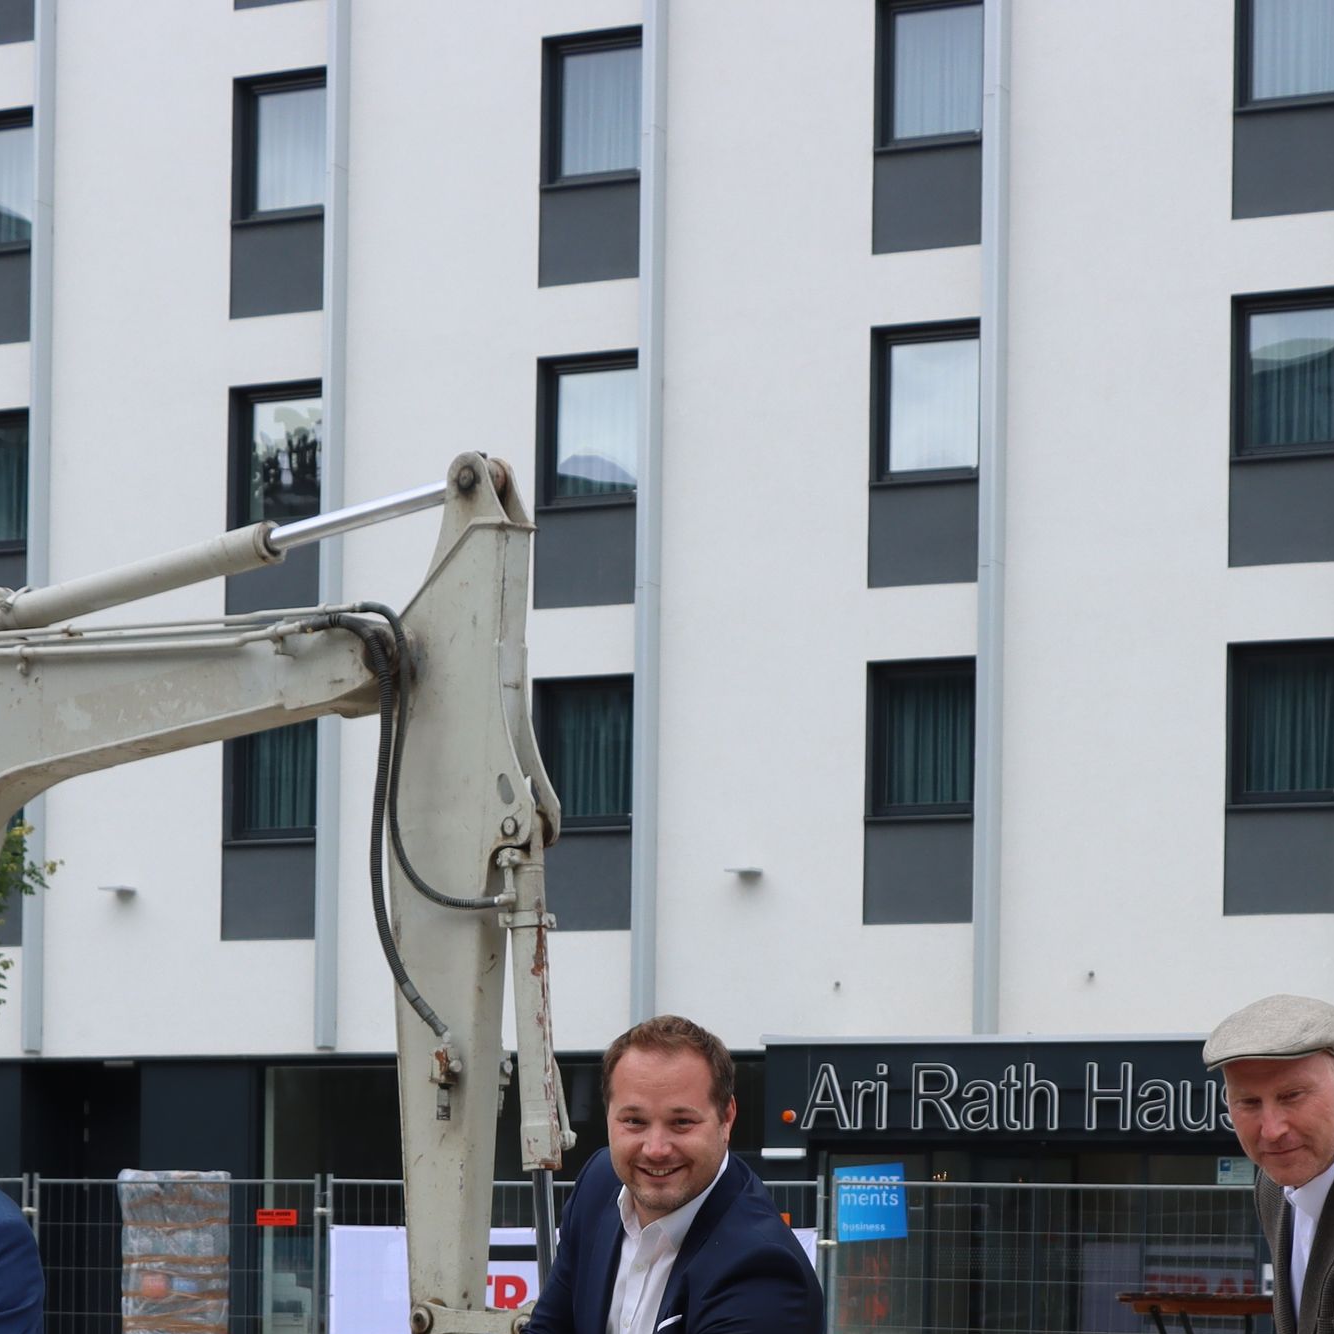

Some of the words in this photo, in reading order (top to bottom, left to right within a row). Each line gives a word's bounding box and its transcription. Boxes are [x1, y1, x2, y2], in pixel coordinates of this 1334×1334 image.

[800, 1063, 889, 1131] Ari
[911, 1063, 1059, 1131] Rath
[841, 1191, 899, 1206] ments
[842, 1222, 886, 1232] business
